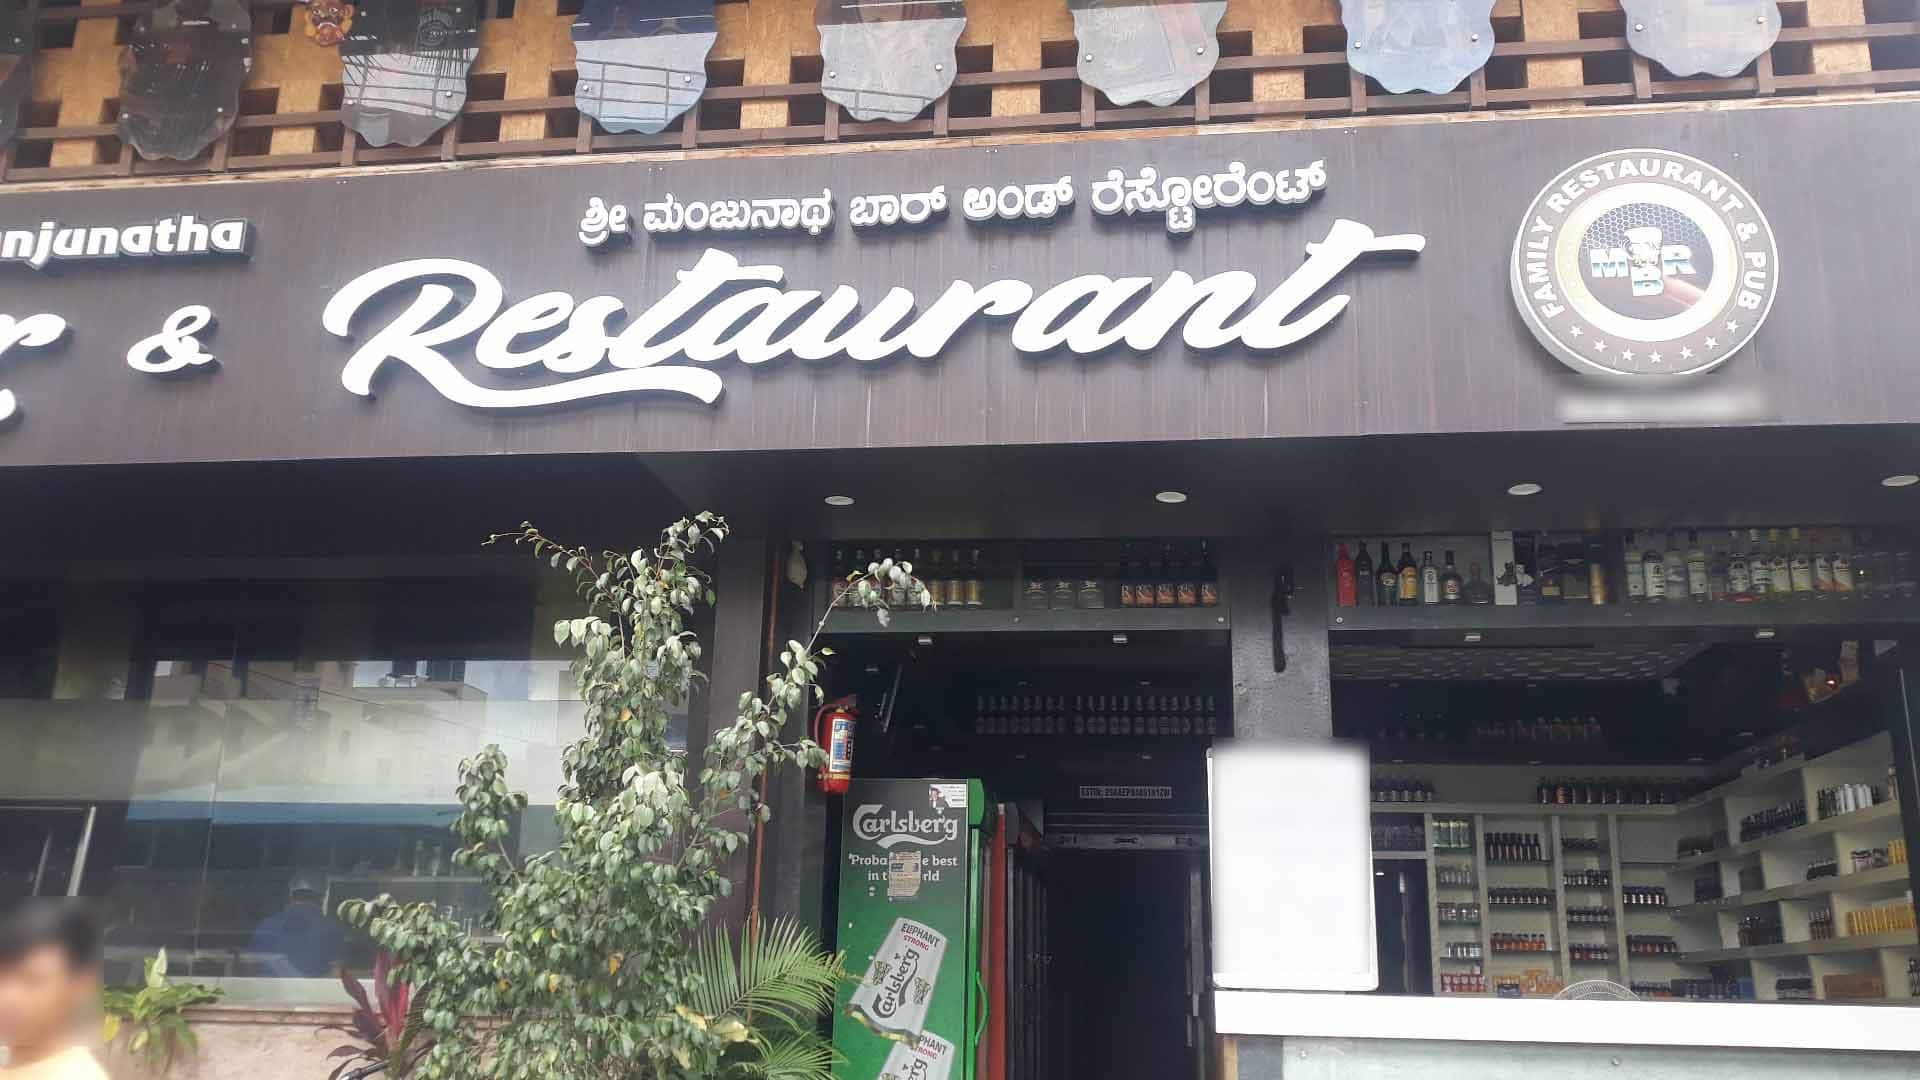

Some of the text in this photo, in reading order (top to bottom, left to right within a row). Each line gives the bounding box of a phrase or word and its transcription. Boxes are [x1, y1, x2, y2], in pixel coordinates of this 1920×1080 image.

[579, 159, 1327, 246] ಶ್ರೀ ಮಂಜುನಾಥ ಬಾರ್ ಅಂಡ್ ರೆಸ್ಟೋರೆಂಟ್
[0, 215, 246, 268] njunatha
[1526, 157, 1767, 318] FAMILY RESTAURANT & PUB
[127, 304, 214, 373] &
[322, 219, 1425, 408] Restaurant
[853, 804, 958, 848] Carlsberg
[868, 870, 880, 881] in
[922, 870, 940, 881] rld
[932, 854, 959, 866] best
[901, 923, 940, 948] ELEPHANT
[903, 934, 929, 951] STRONG
[872, 948, 920, 1018] Carlsberg
[920, 1034, 947, 1056] PHANT
